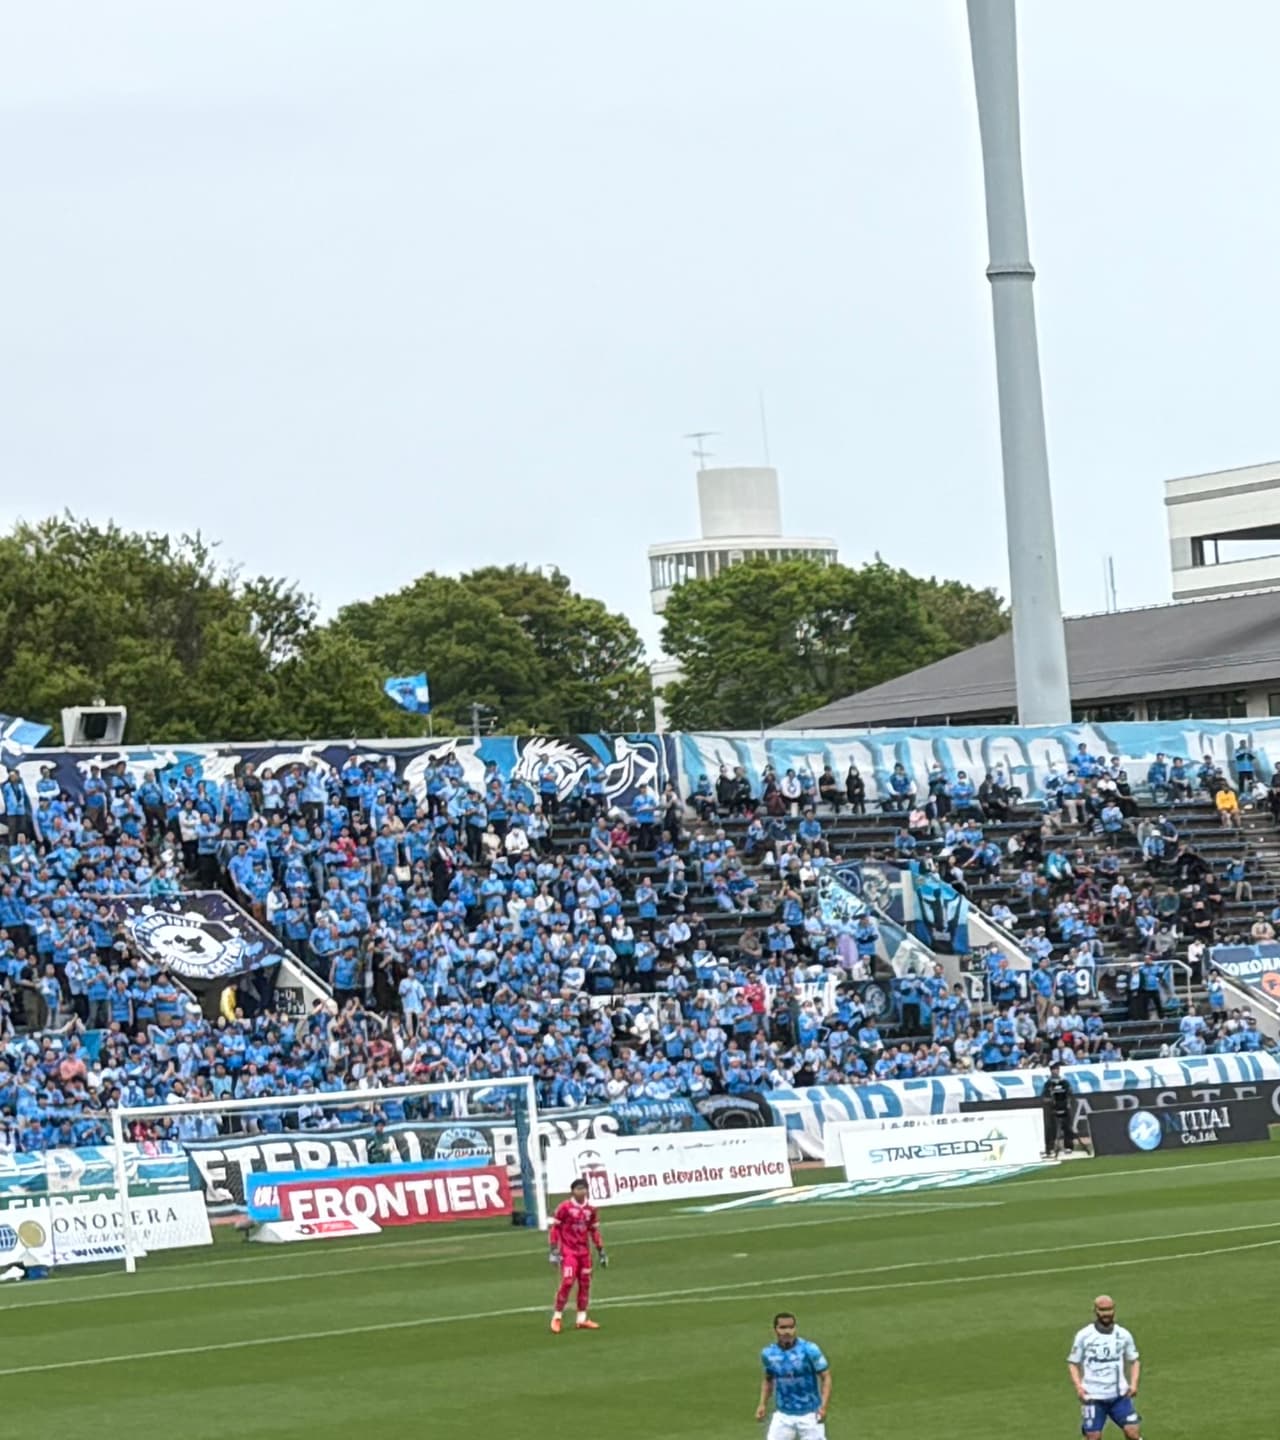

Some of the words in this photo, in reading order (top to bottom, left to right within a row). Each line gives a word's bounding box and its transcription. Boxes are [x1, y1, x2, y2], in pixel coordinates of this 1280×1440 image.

[868, 1137, 994, 1163] STARSEEDS
[729, 1160, 785, 1179] service
[288, 1174, 505, 1223] FRONTIER
